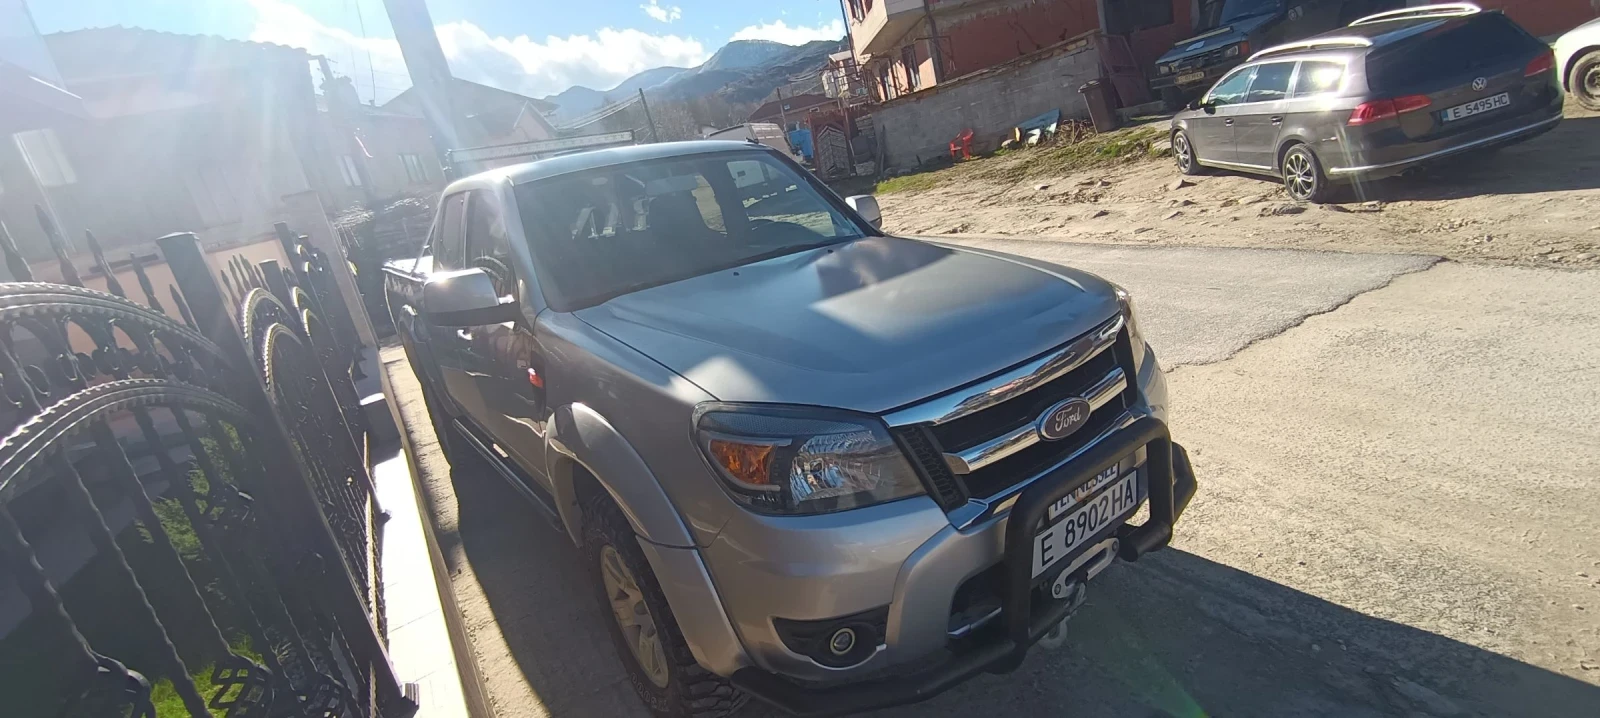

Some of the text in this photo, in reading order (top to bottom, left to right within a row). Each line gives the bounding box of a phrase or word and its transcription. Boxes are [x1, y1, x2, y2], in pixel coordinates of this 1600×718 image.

[1453, 108, 1461, 118] E
[1055, 406, 1081, 432] Ford
[1042, 532, 1054, 566] E
